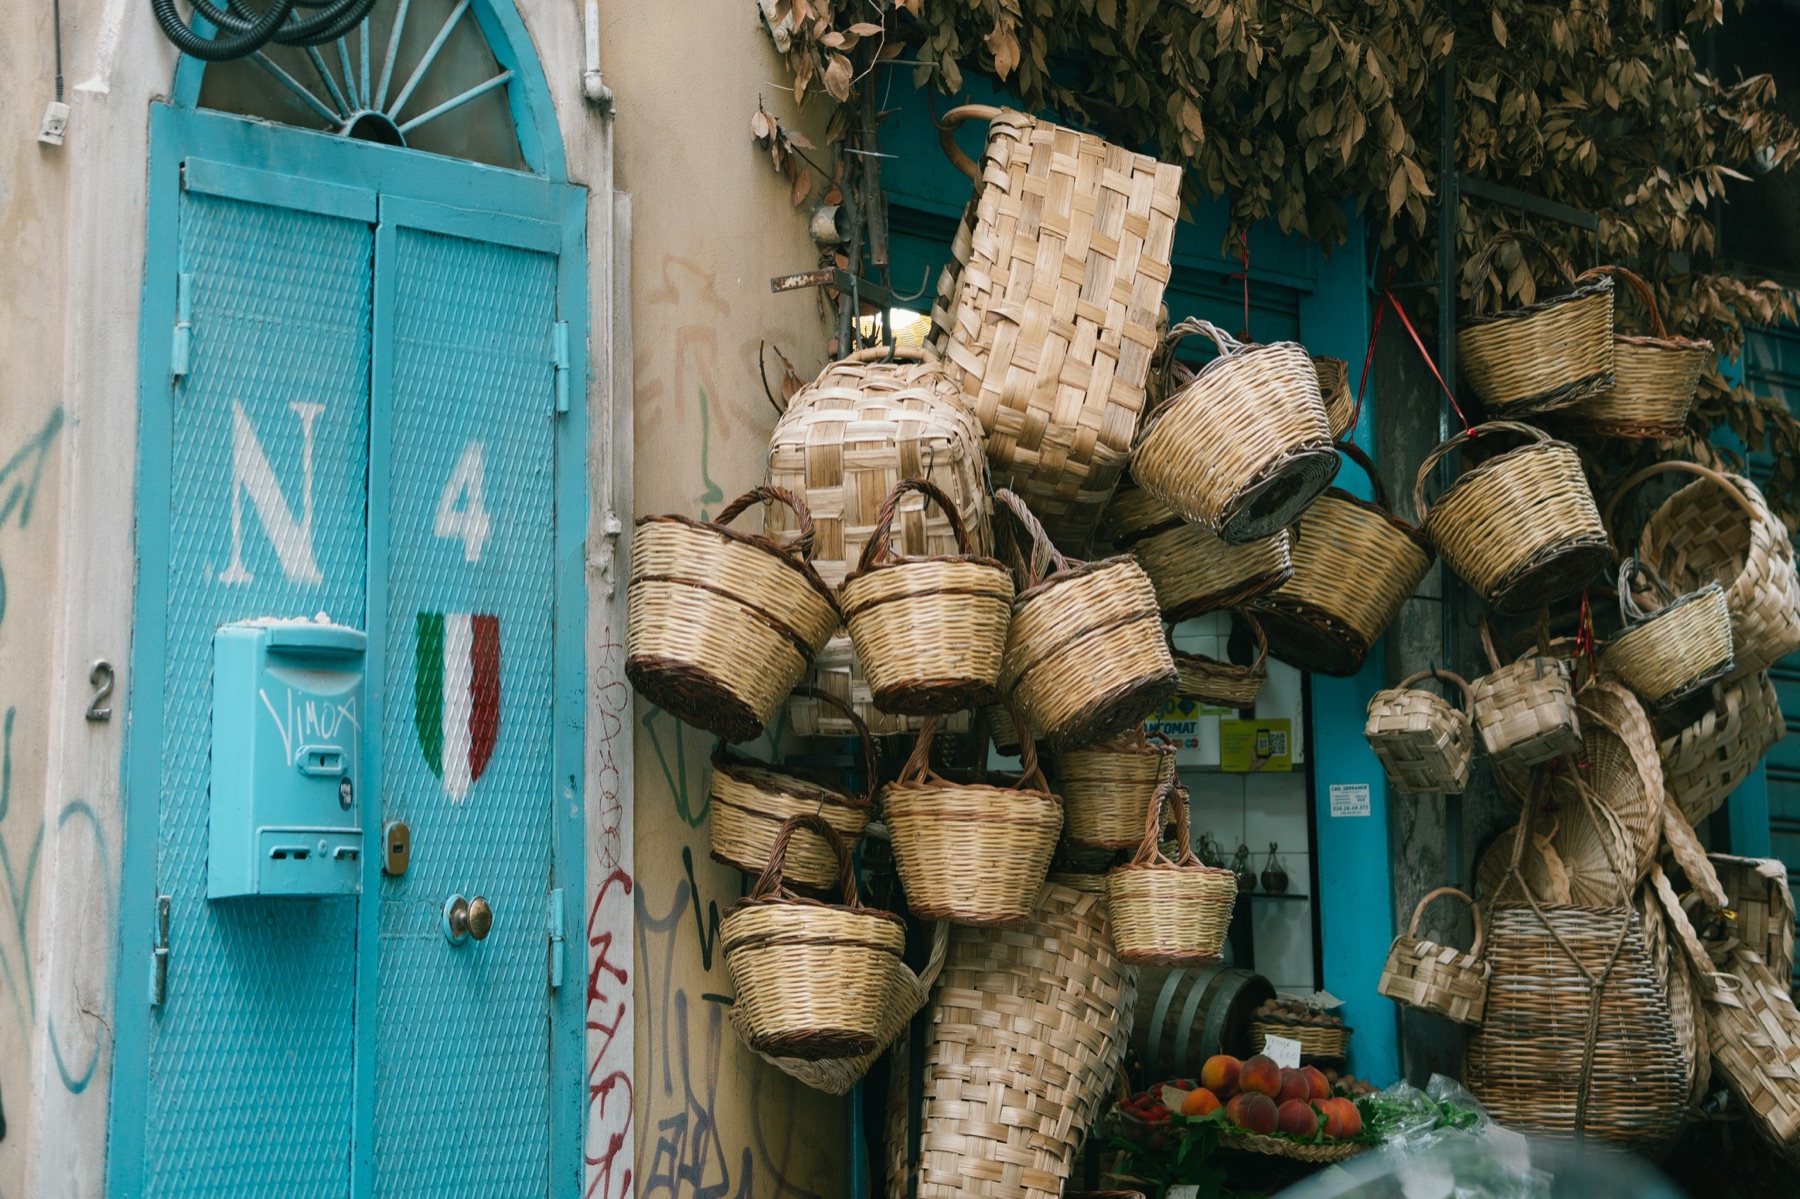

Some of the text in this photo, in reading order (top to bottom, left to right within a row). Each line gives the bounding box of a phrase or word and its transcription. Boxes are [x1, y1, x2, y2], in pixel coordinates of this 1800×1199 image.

[218, 398, 491, 584] N 4
[85, 658, 114, 722] 2
